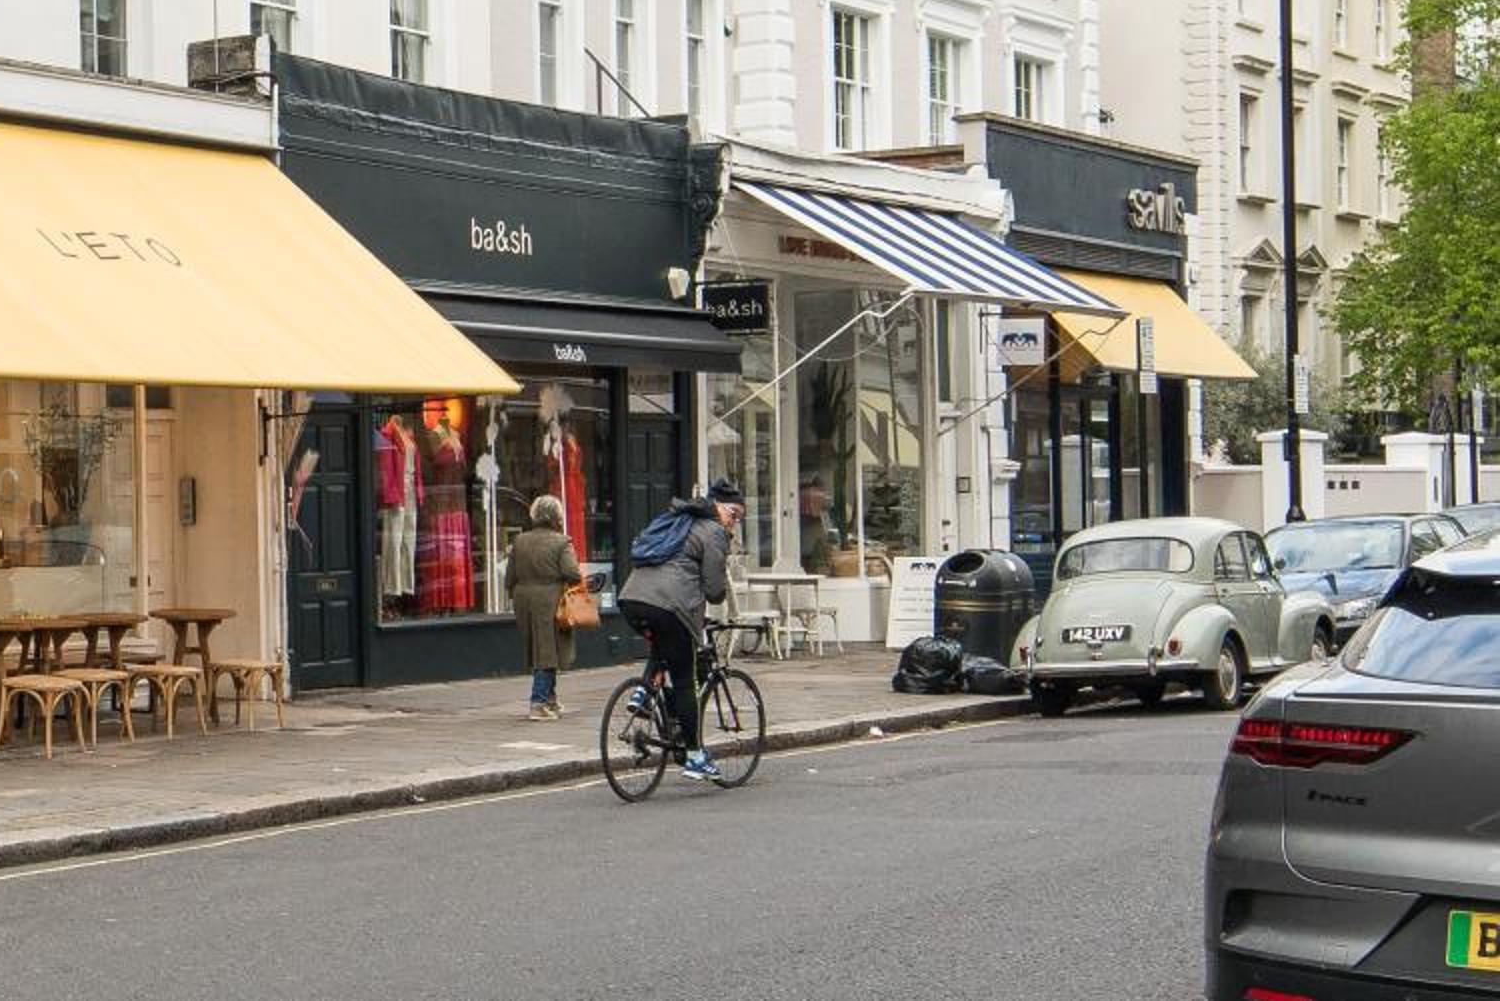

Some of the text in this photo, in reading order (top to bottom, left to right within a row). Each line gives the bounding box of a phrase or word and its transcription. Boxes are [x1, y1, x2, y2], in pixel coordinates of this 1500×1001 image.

[35, 227, 182, 267] L'ETO
[471, 218, 533, 256] ba&sh
[1069, 626, 1125, 642] 142 UXV
